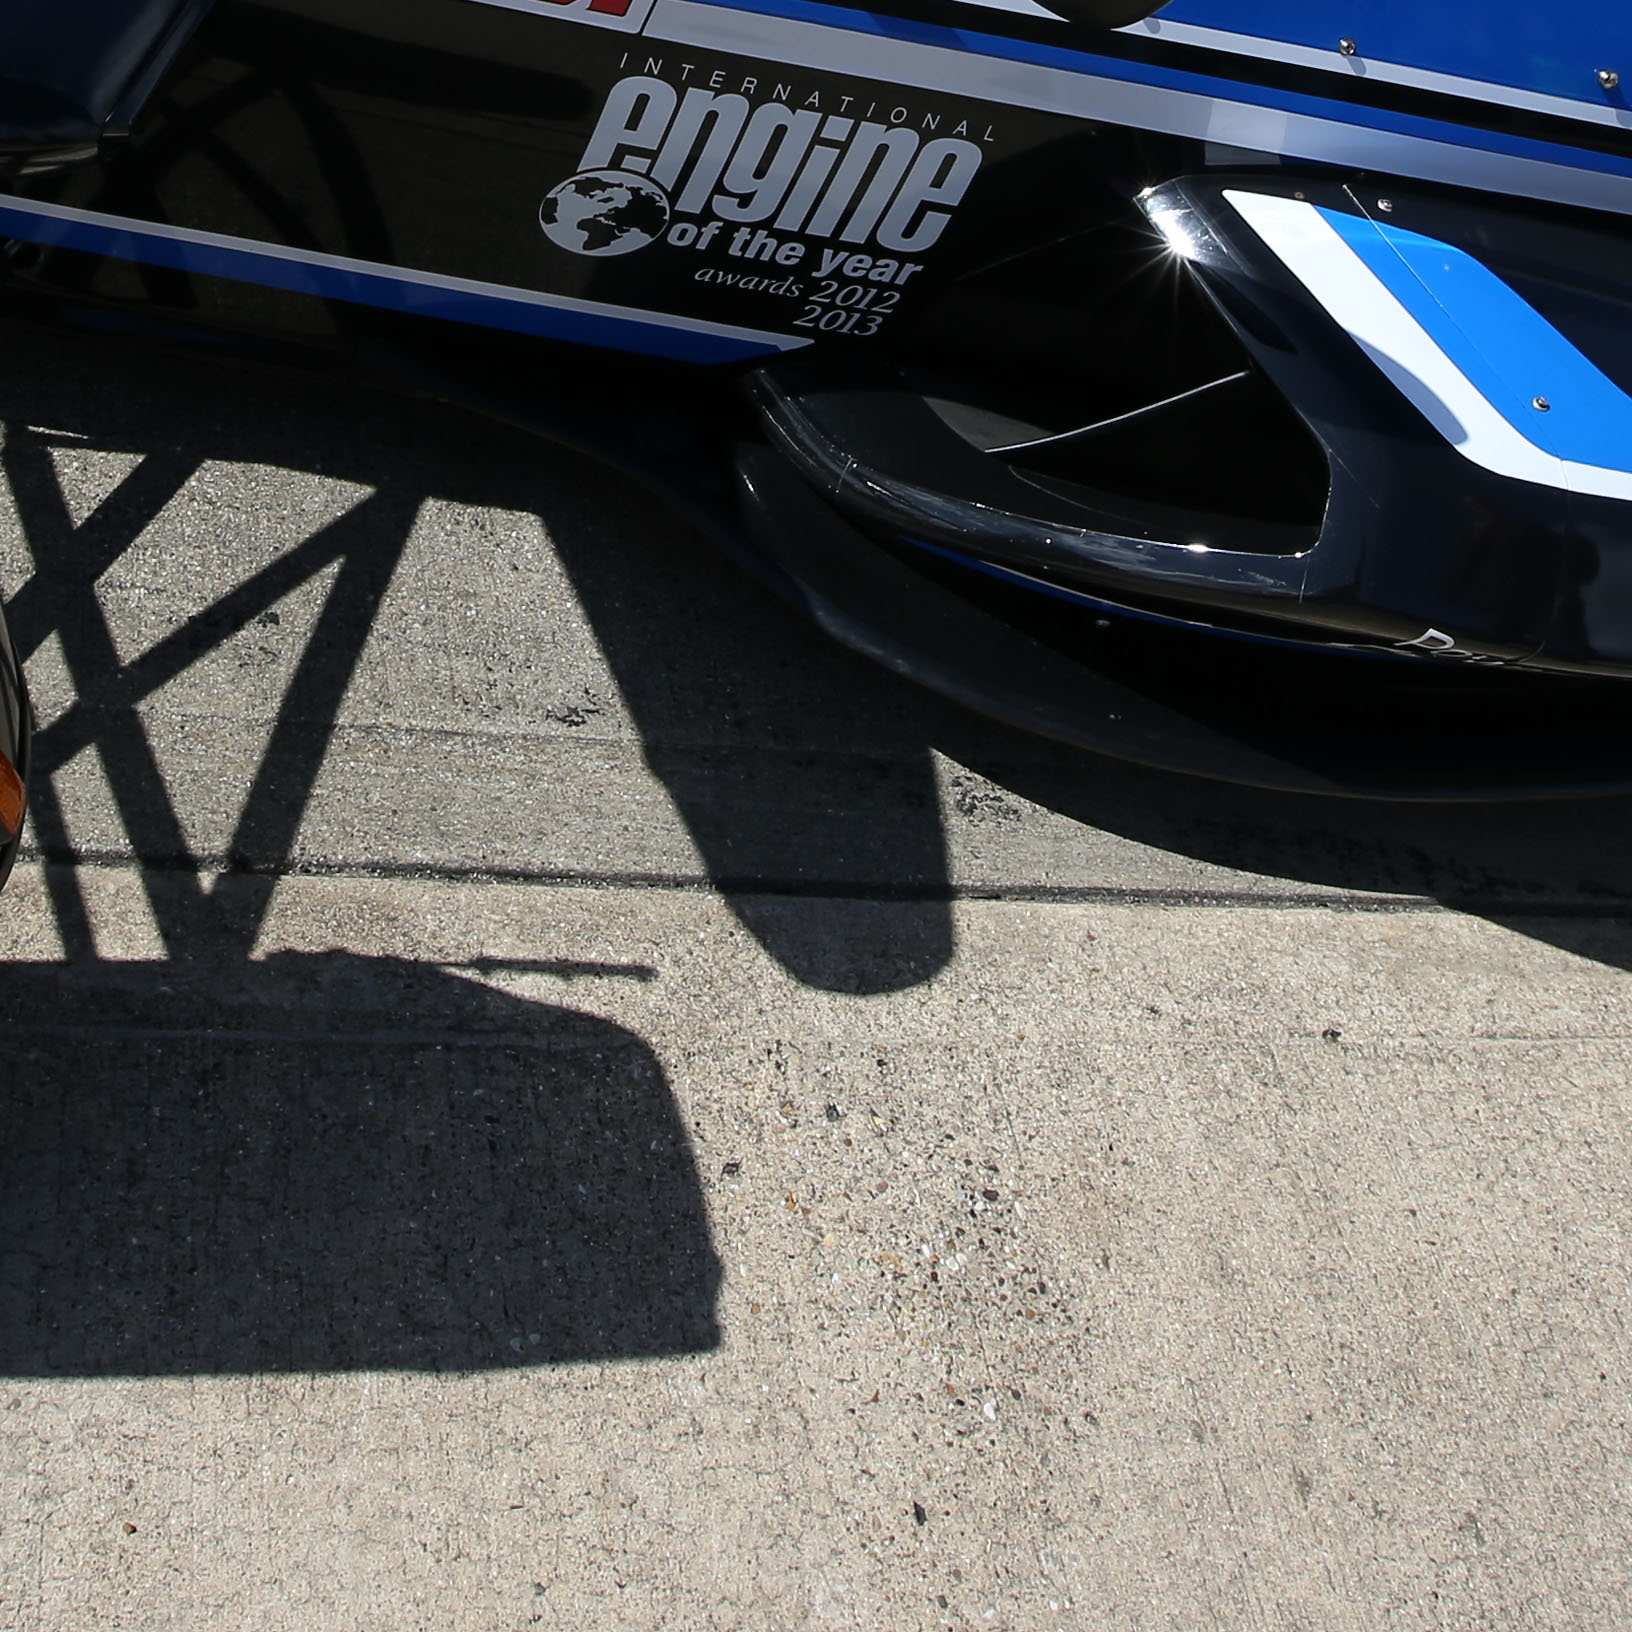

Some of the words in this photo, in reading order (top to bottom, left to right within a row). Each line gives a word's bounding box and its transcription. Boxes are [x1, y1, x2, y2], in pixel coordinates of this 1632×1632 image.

[619, 52, 996, 142] INTERNATIONAL
[576, 76, 984, 254] engine
[667, 221, 724, 250] of
[728, 227, 806, 265] the
[811, 248, 925, 285] year
[694, 267, 805, 297] awards
[808, 280, 901, 313] 2012
[792, 305, 884, 336] 2013
